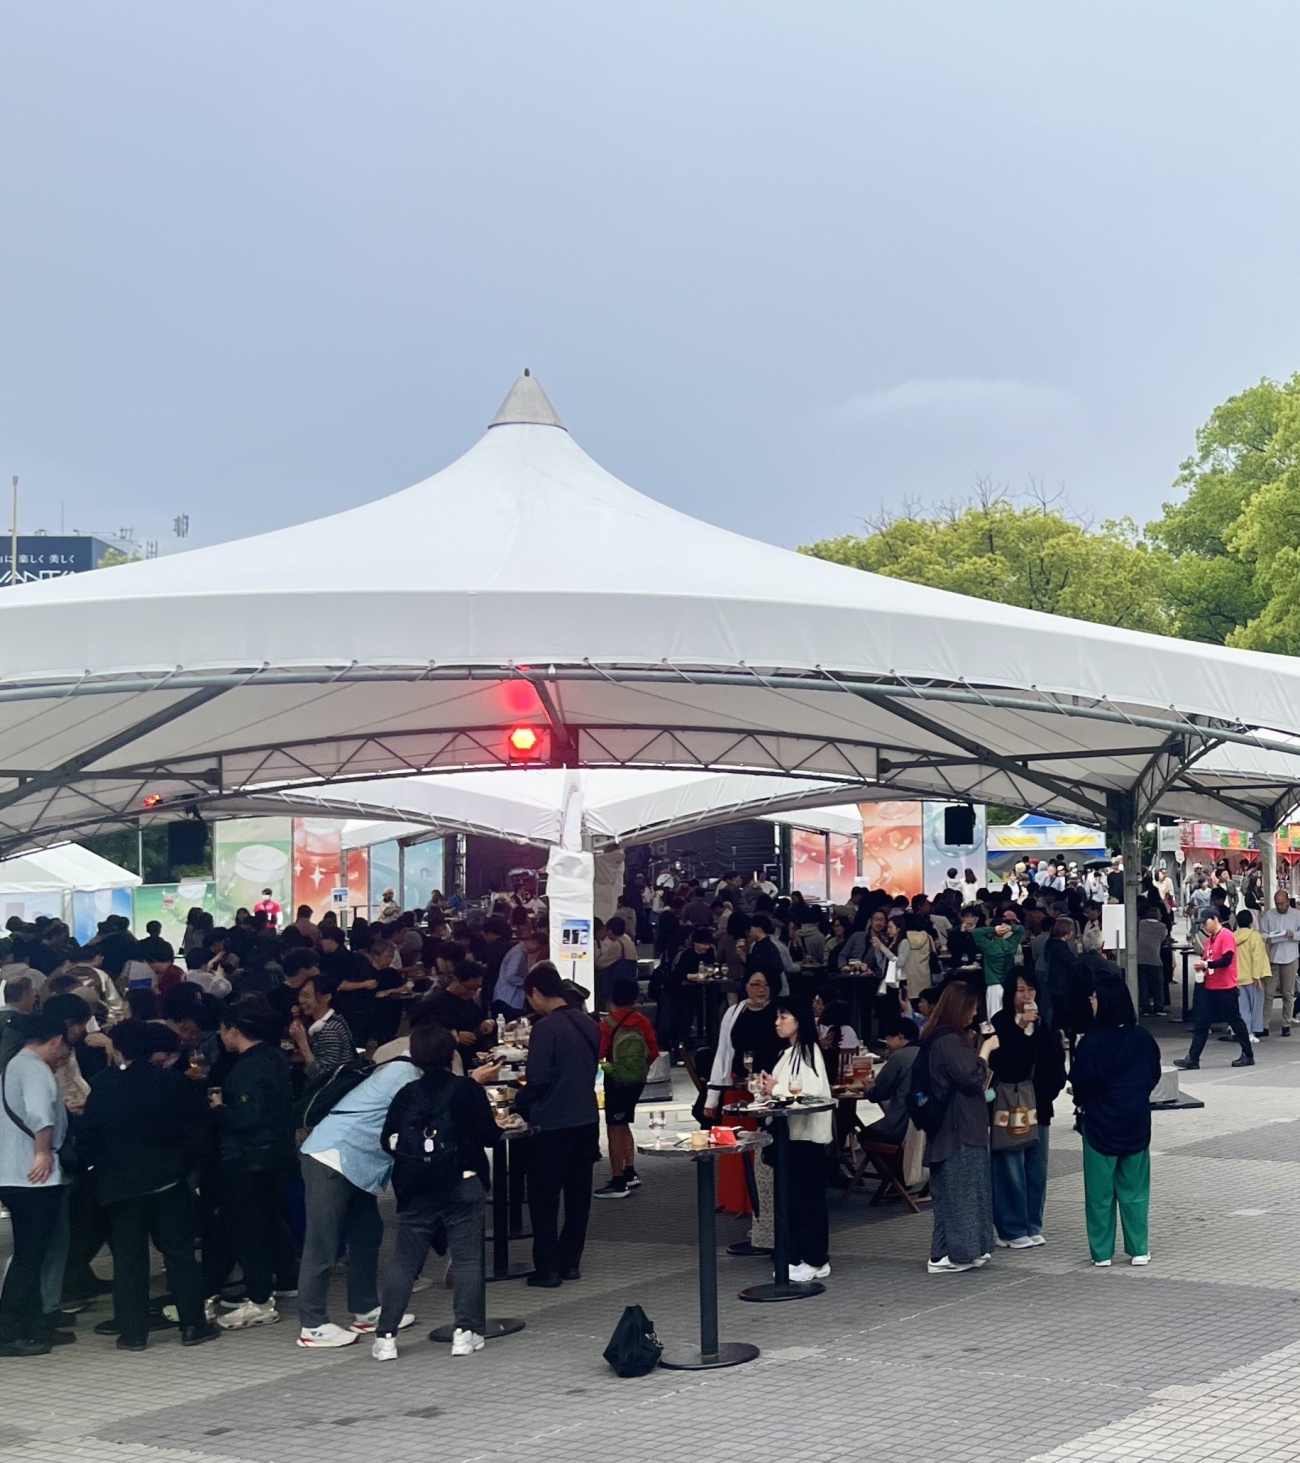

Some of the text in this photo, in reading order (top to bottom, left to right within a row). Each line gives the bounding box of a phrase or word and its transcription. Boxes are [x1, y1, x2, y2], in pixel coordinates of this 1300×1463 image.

[19, 554, 44, 563] 楽しく
[49, 554, 74, 563] 美しく
